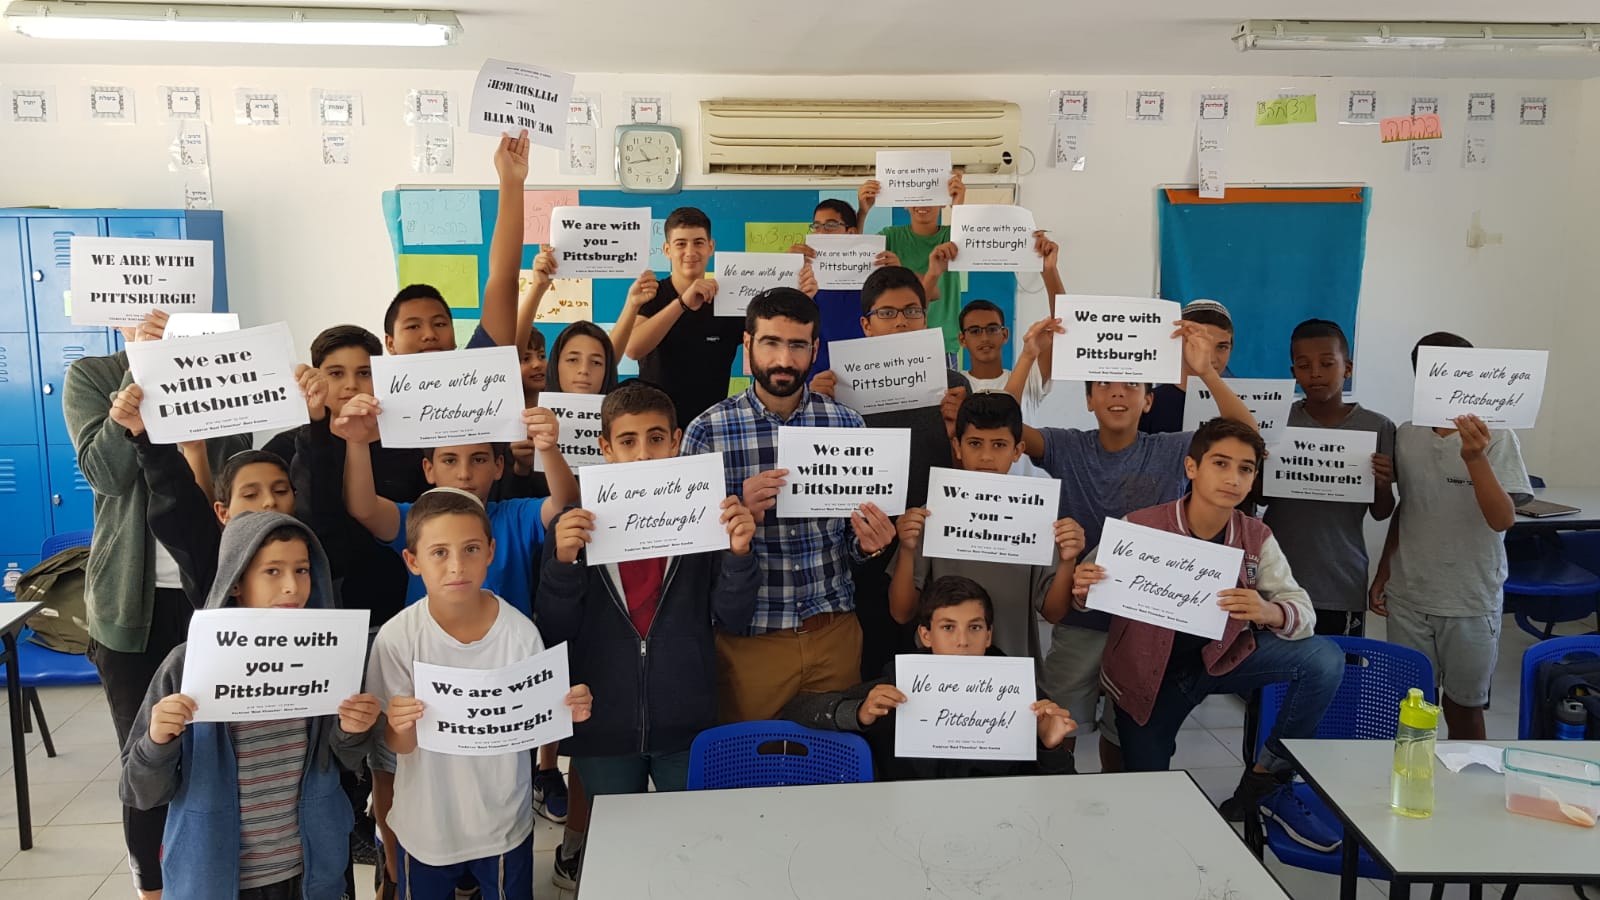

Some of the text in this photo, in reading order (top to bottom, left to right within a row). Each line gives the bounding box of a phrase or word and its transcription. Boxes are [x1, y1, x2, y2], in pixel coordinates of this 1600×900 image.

[488, 79, 558, 103] PITTSBURGH!
[516, 100, 535, 113] YOU
[484, 112, 552, 133] WE ARE WITH
[889, 179, 939, 189] Pittsburgh!
[562, 220, 582, 229] We
[610, 222, 640, 230] with
[584, 239, 607, 247] you
[966, 239, 1026, 251] Pittsburgh!
[91, 255, 194, 266] WE ARE WITH
[563, 252, 637, 263] Pittsburgh!
[724, 264, 737, 276] We
[759, 267, 776, 276] with
[778, 270, 793, 281] you
[820, 262, 871, 272] Pittsburgh!
[123, 275, 152, 285] YOU
[91, 293, 195, 304] PITTSBURGH!
[1075, 311, 1161, 323] We are with
[1097, 332, 1123, 342] you
[174, 350, 252, 369] We are
[1076, 348, 1157, 362] Pittsburgh!
[844, 363, 861, 372] We
[864, 362, 880, 370] are
[883, 357, 904, 369] with
[908, 357, 924, 367] you
[1429, 362, 1531, 385] We are with you
[160, 377, 212, 394] with
[216, 372, 257, 387] you
[390, 369, 507, 394] We are with you
[852, 371, 926, 391] Pittsburgh!
[159, 387, 286, 418] Pittsburgh!
[1252, 392, 1282, 400] with
[1449, 390, 1524, 411] Pittsburgh!
[420, 399, 503, 423] Pittsburgh!
[551, 408, 601, 420] We are
[813, 444, 874, 456] We are
[1294, 440, 1345, 452] We are
[1280, 456, 1313, 466] with
[1317, 459, 1344, 468] you
[798, 464, 837, 475] with
[841, 466, 873, 476] you
[1276, 470, 1361, 484] Pittsburgh!
[597, 478, 709, 503] We are with you
[792, 483, 893, 495] Pittsburgh!
[943, 486, 1044, 506] We are with
[625, 506, 706, 531] Pittsburgh!
[969, 512, 998, 522] you
[944, 526, 1036, 545] Pittsburgh!
[1112, 539, 1222, 580] We are with you
[1129, 575, 1211, 607] Pittsburgh!
[216, 631, 338, 646] We are with
[246, 662, 283, 676] you
[215, 680, 329, 699] Pittsburgh!
[432, 669, 553, 697] We are with
[912, 674, 1020, 701] We are with you
[468, 706, 506, 718] you
[438, 709, 553, 735] Pittsburgh!
[936, 709, 1016, 734] Pittsburgh!
